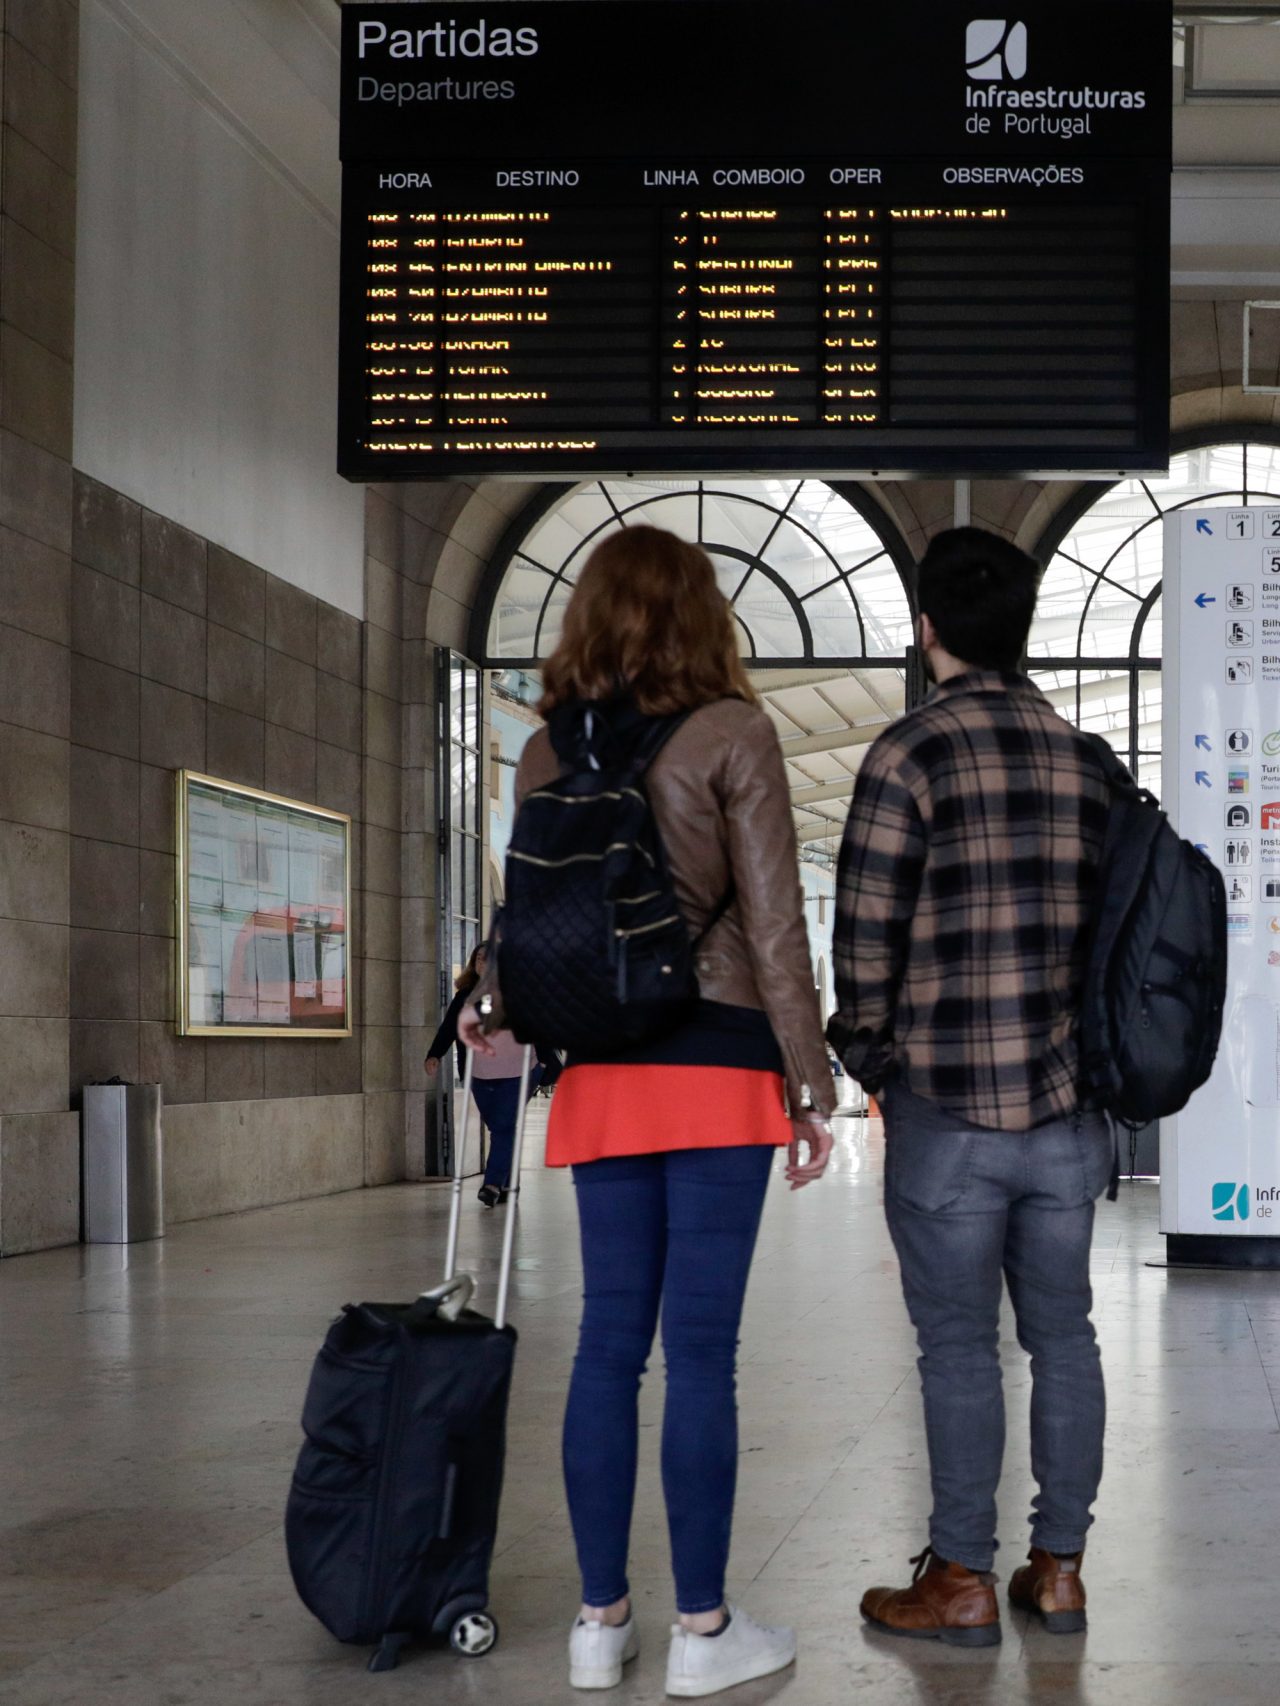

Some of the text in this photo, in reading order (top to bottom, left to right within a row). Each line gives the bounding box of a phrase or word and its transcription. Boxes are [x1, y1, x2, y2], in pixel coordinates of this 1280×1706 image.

[357, 19, 539, 59] Partidas
[357, 76, 516, 107] Departures
[966, 86, 1146, 109] Infraestruturas
[966, 112, 1091, 140] de Portugal
[379, 164, 1084, 189] HORA DESTINO LINHA COMBOIO OPER OBSERVAÇÕES
[1236, 520, 1244, 537] 1
[1256, 1204, 1272, 1218] de
